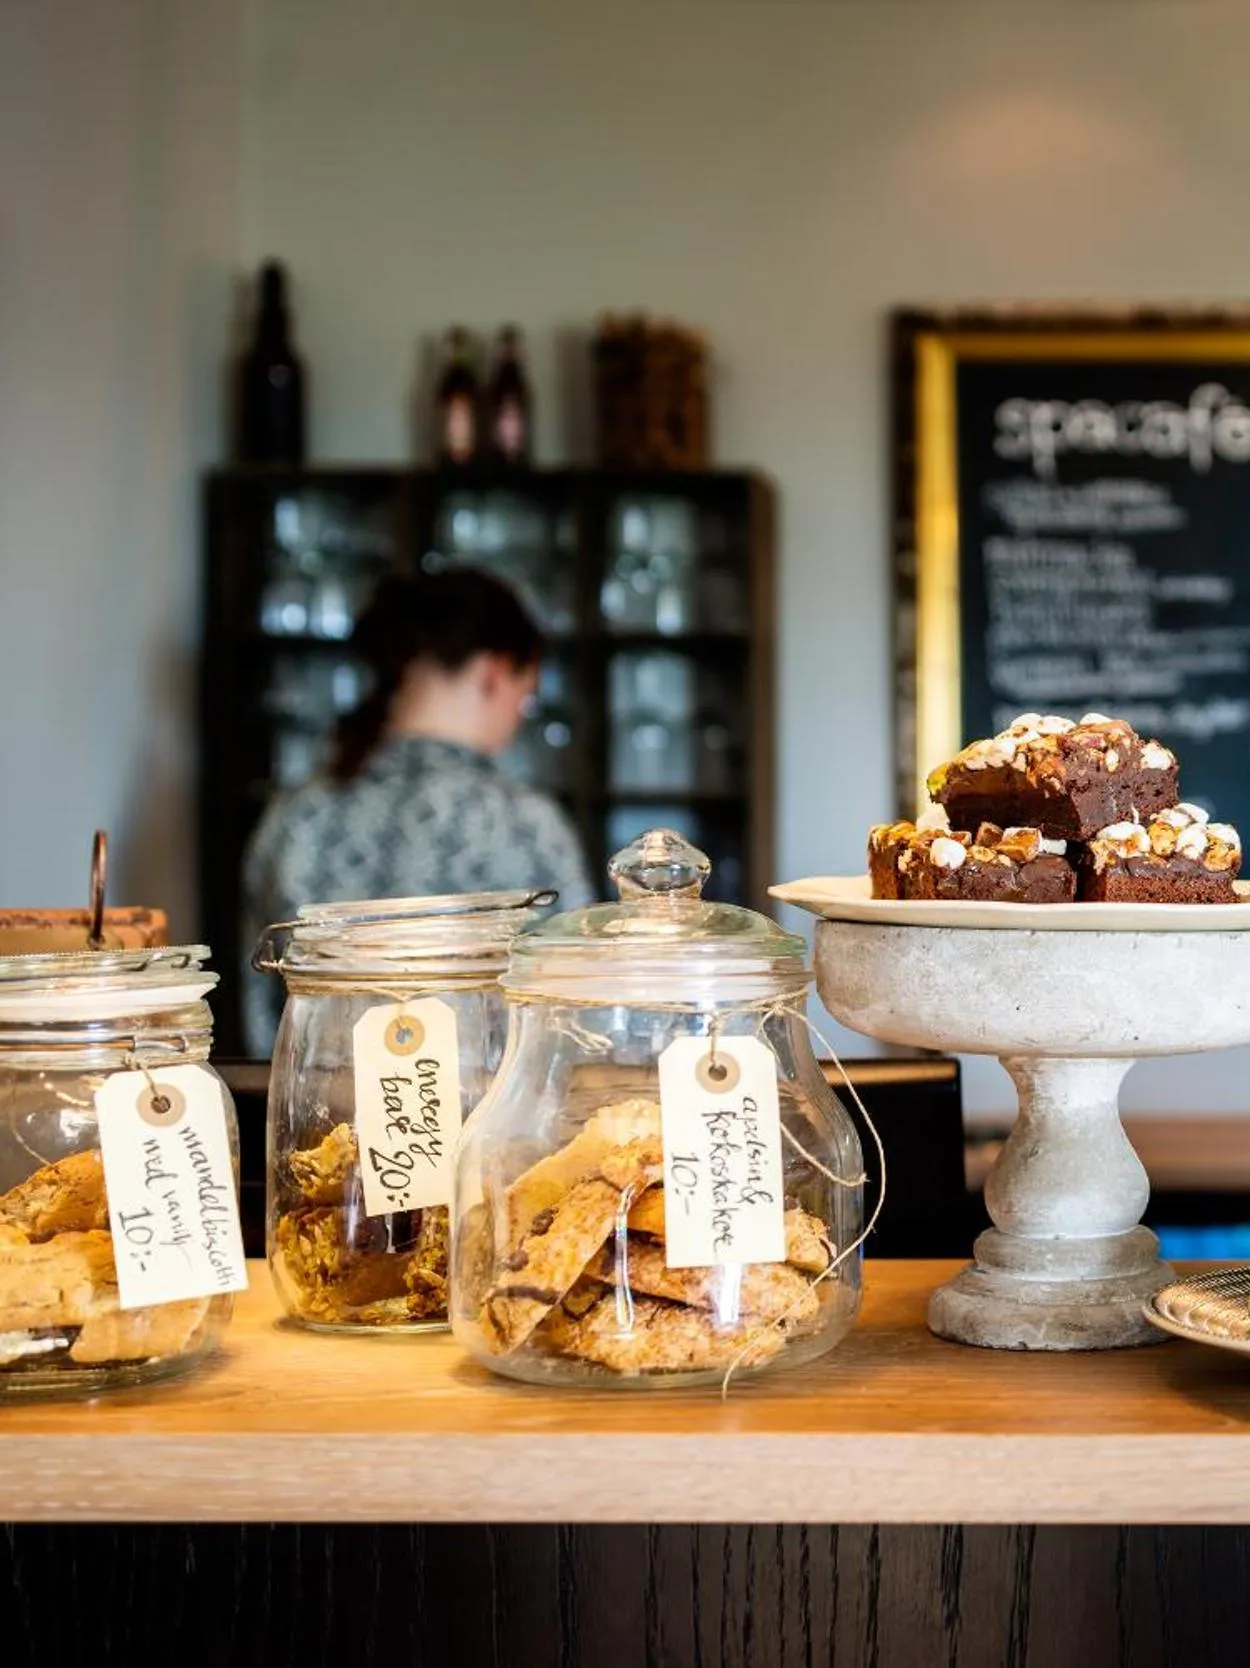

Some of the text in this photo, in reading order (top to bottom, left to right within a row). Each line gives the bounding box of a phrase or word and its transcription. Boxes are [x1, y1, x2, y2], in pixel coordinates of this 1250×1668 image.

[410, 1058, 443, 1168] energy
[736, 1096, 774, 1205] apelsin &
[178, 1126, 237, 1287] mandelbiscotti
